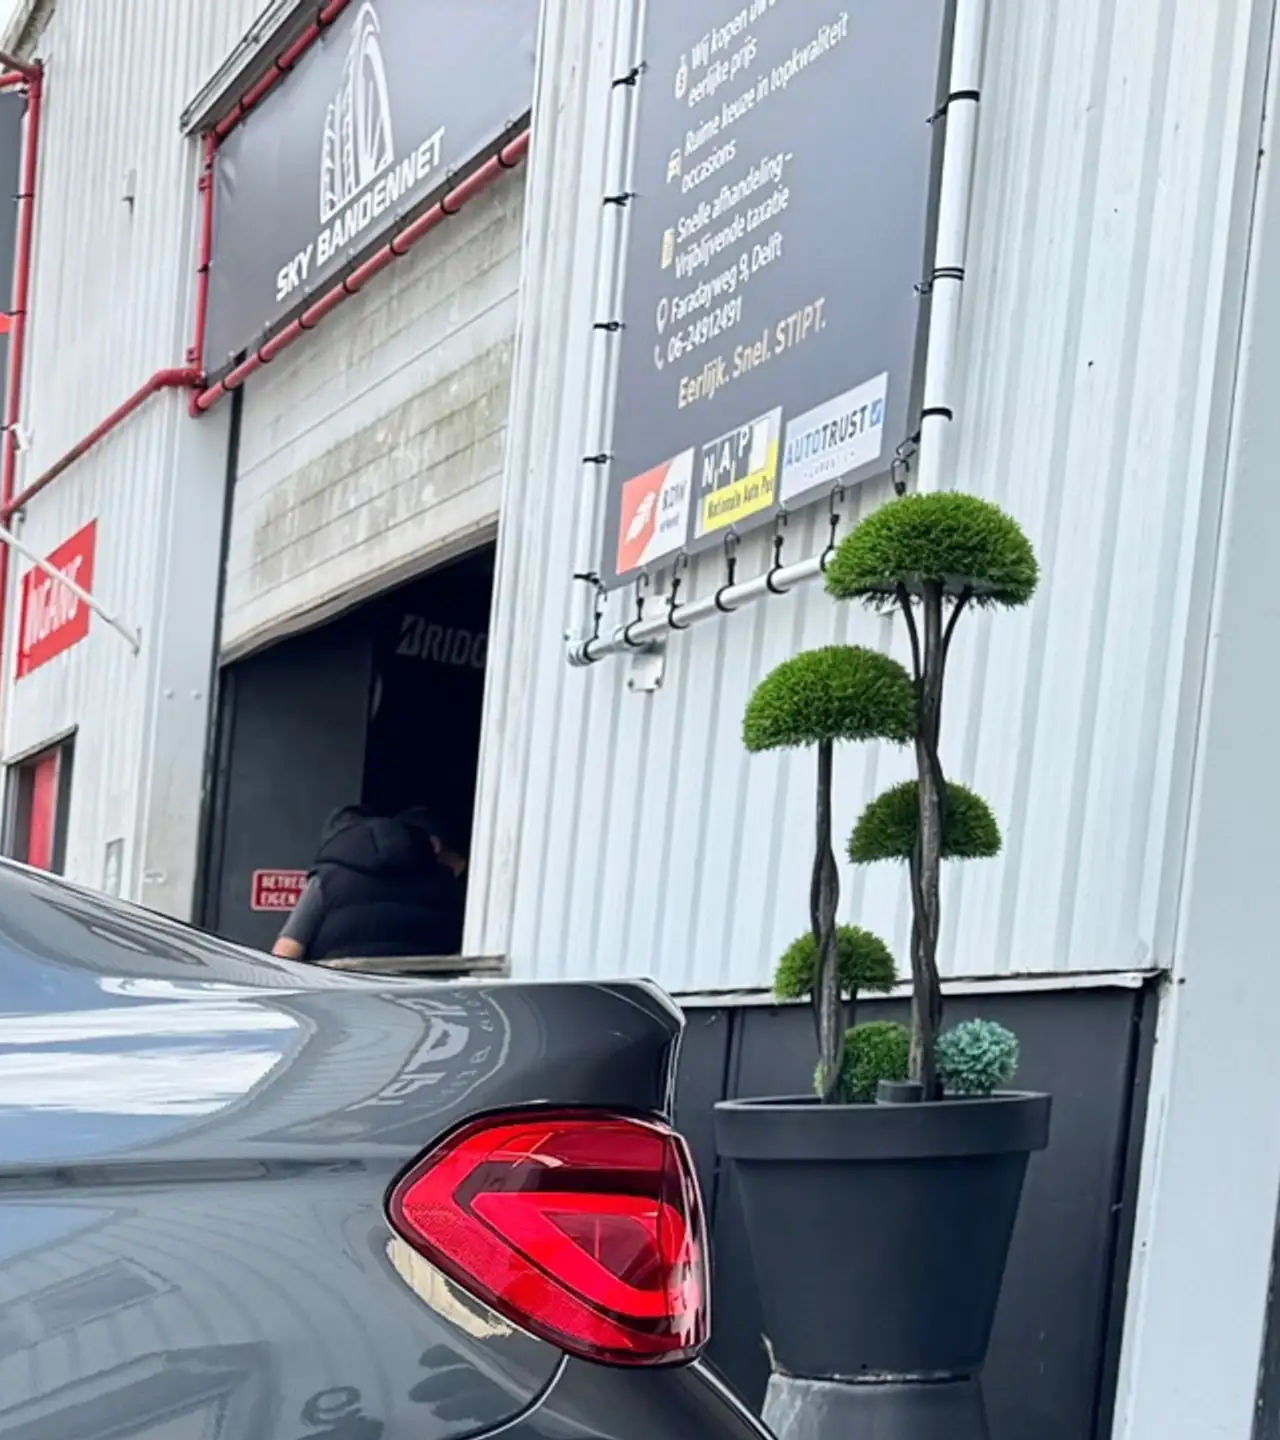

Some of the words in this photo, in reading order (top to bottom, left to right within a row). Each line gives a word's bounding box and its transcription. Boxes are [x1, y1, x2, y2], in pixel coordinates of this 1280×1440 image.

[276, 243, 314, 302] SKY
[316, 125, 446, 267] BANDENNET
[751, 231, 783, 273] Delft
[678, 356, 730, 410] Eerlijk.
[732, 328, 772, 379] Snel.
[774, 296, 827, 355] STIPT.
[784, 404, 869, 465] AUTOTRUST
